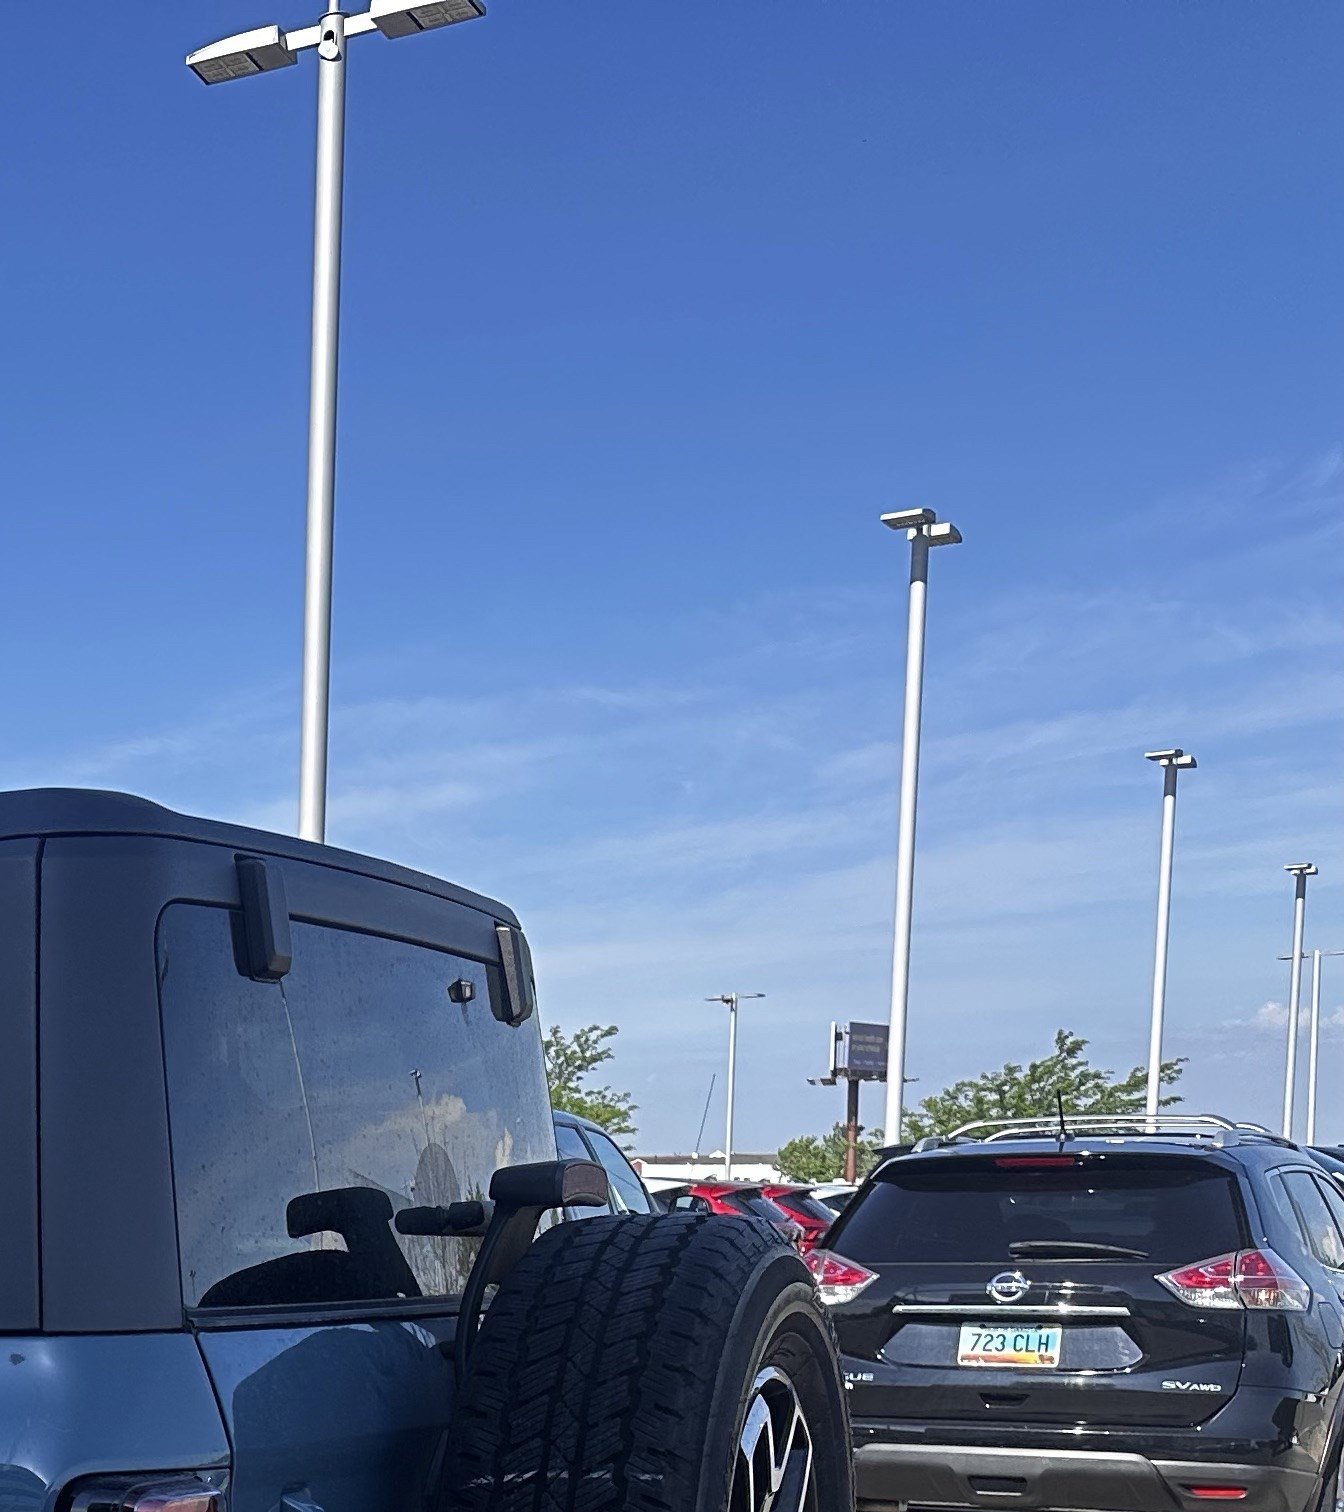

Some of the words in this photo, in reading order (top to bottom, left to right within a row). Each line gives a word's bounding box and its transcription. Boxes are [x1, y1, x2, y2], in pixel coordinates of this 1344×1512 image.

[971, 1333, 1007, 1352] 723
[1013, 1334, 1050, 1353] CLH
[1162, 1380, 1191, 1390] SV
[1189, 1383, 1222, 1392] AWD
